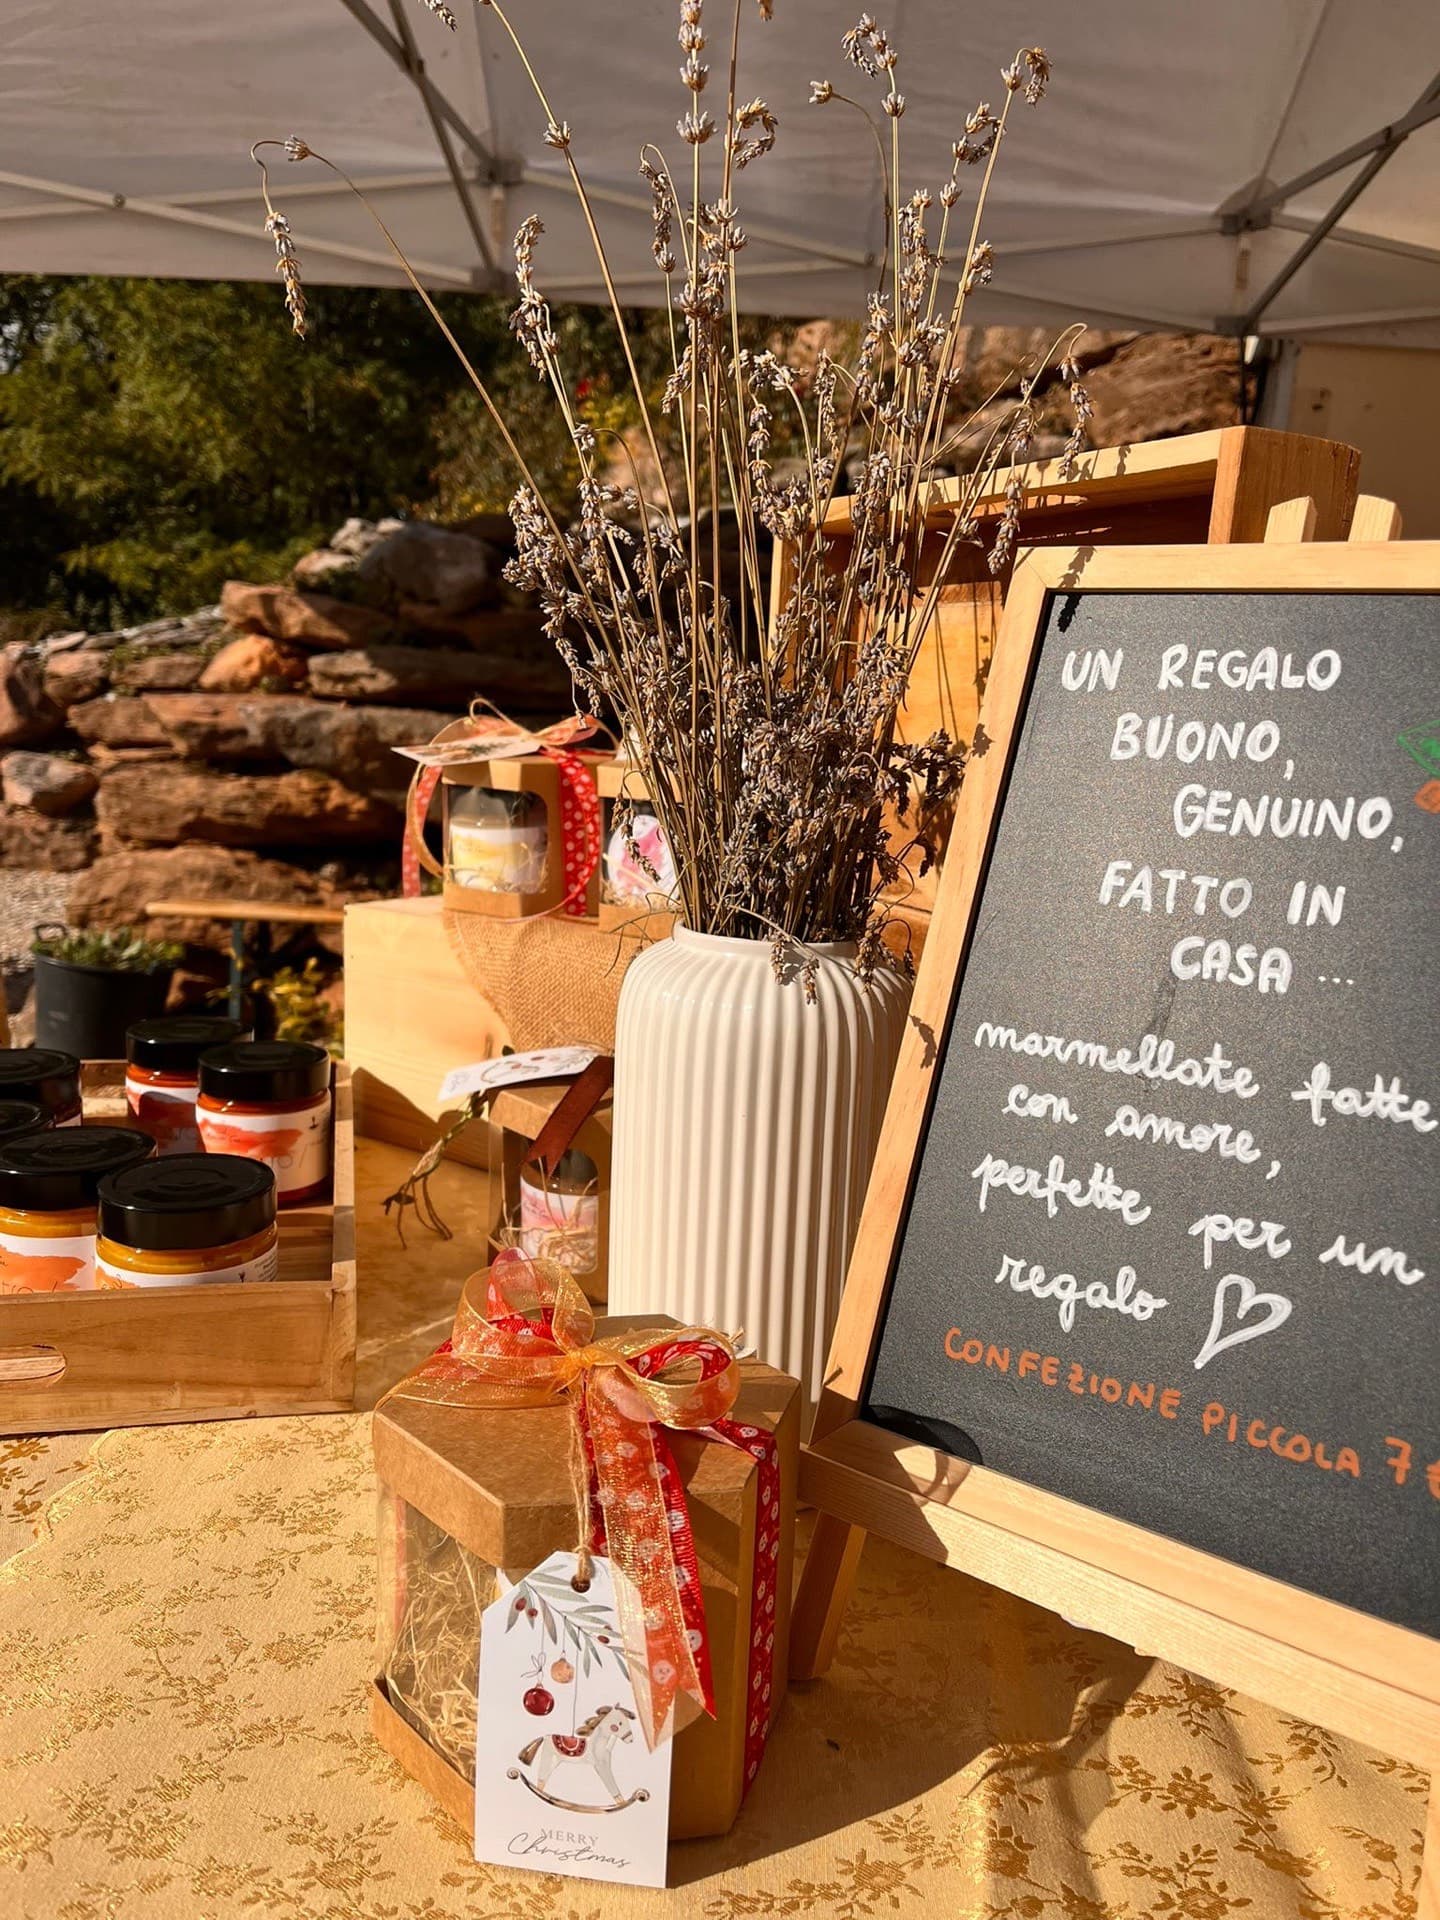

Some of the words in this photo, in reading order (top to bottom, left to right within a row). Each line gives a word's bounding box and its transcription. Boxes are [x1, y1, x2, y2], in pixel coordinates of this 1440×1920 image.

[1060, 648, 1124, 692] UN
[1157, 643, 1342, 692] REGALO
[1110, 712, 1295, 781] BUONO,
[1173, 783, 1404, 853] GENUINO,
[1100, 860, 1253, 918] FATTO
[1286, 880, 1347, 927] IN
[1171, 935, 1293, 995] CASA
[974, 1021, 1260, 1099] marmellate
[1291, 1062, 1439, 1132] fatte
[1002, 1084, 1079, 1124] con
[1105, 1105, 1281, 1180] amore,
[972, 1153, 1151, 1225] perfette
[1188, 1213, 1292, 1269] per
[1319, 1235, 1425, 1285] un
[995, 1255, 1168, 1332] regalo
[943, 1327, 1182, 1419] CONFEZIONE
[1202, 1402, 1361, 1478] PICCOLA
[507, 1832, 631, 1868] Christmas
[541, 1828, 599, 1847] MERRY
